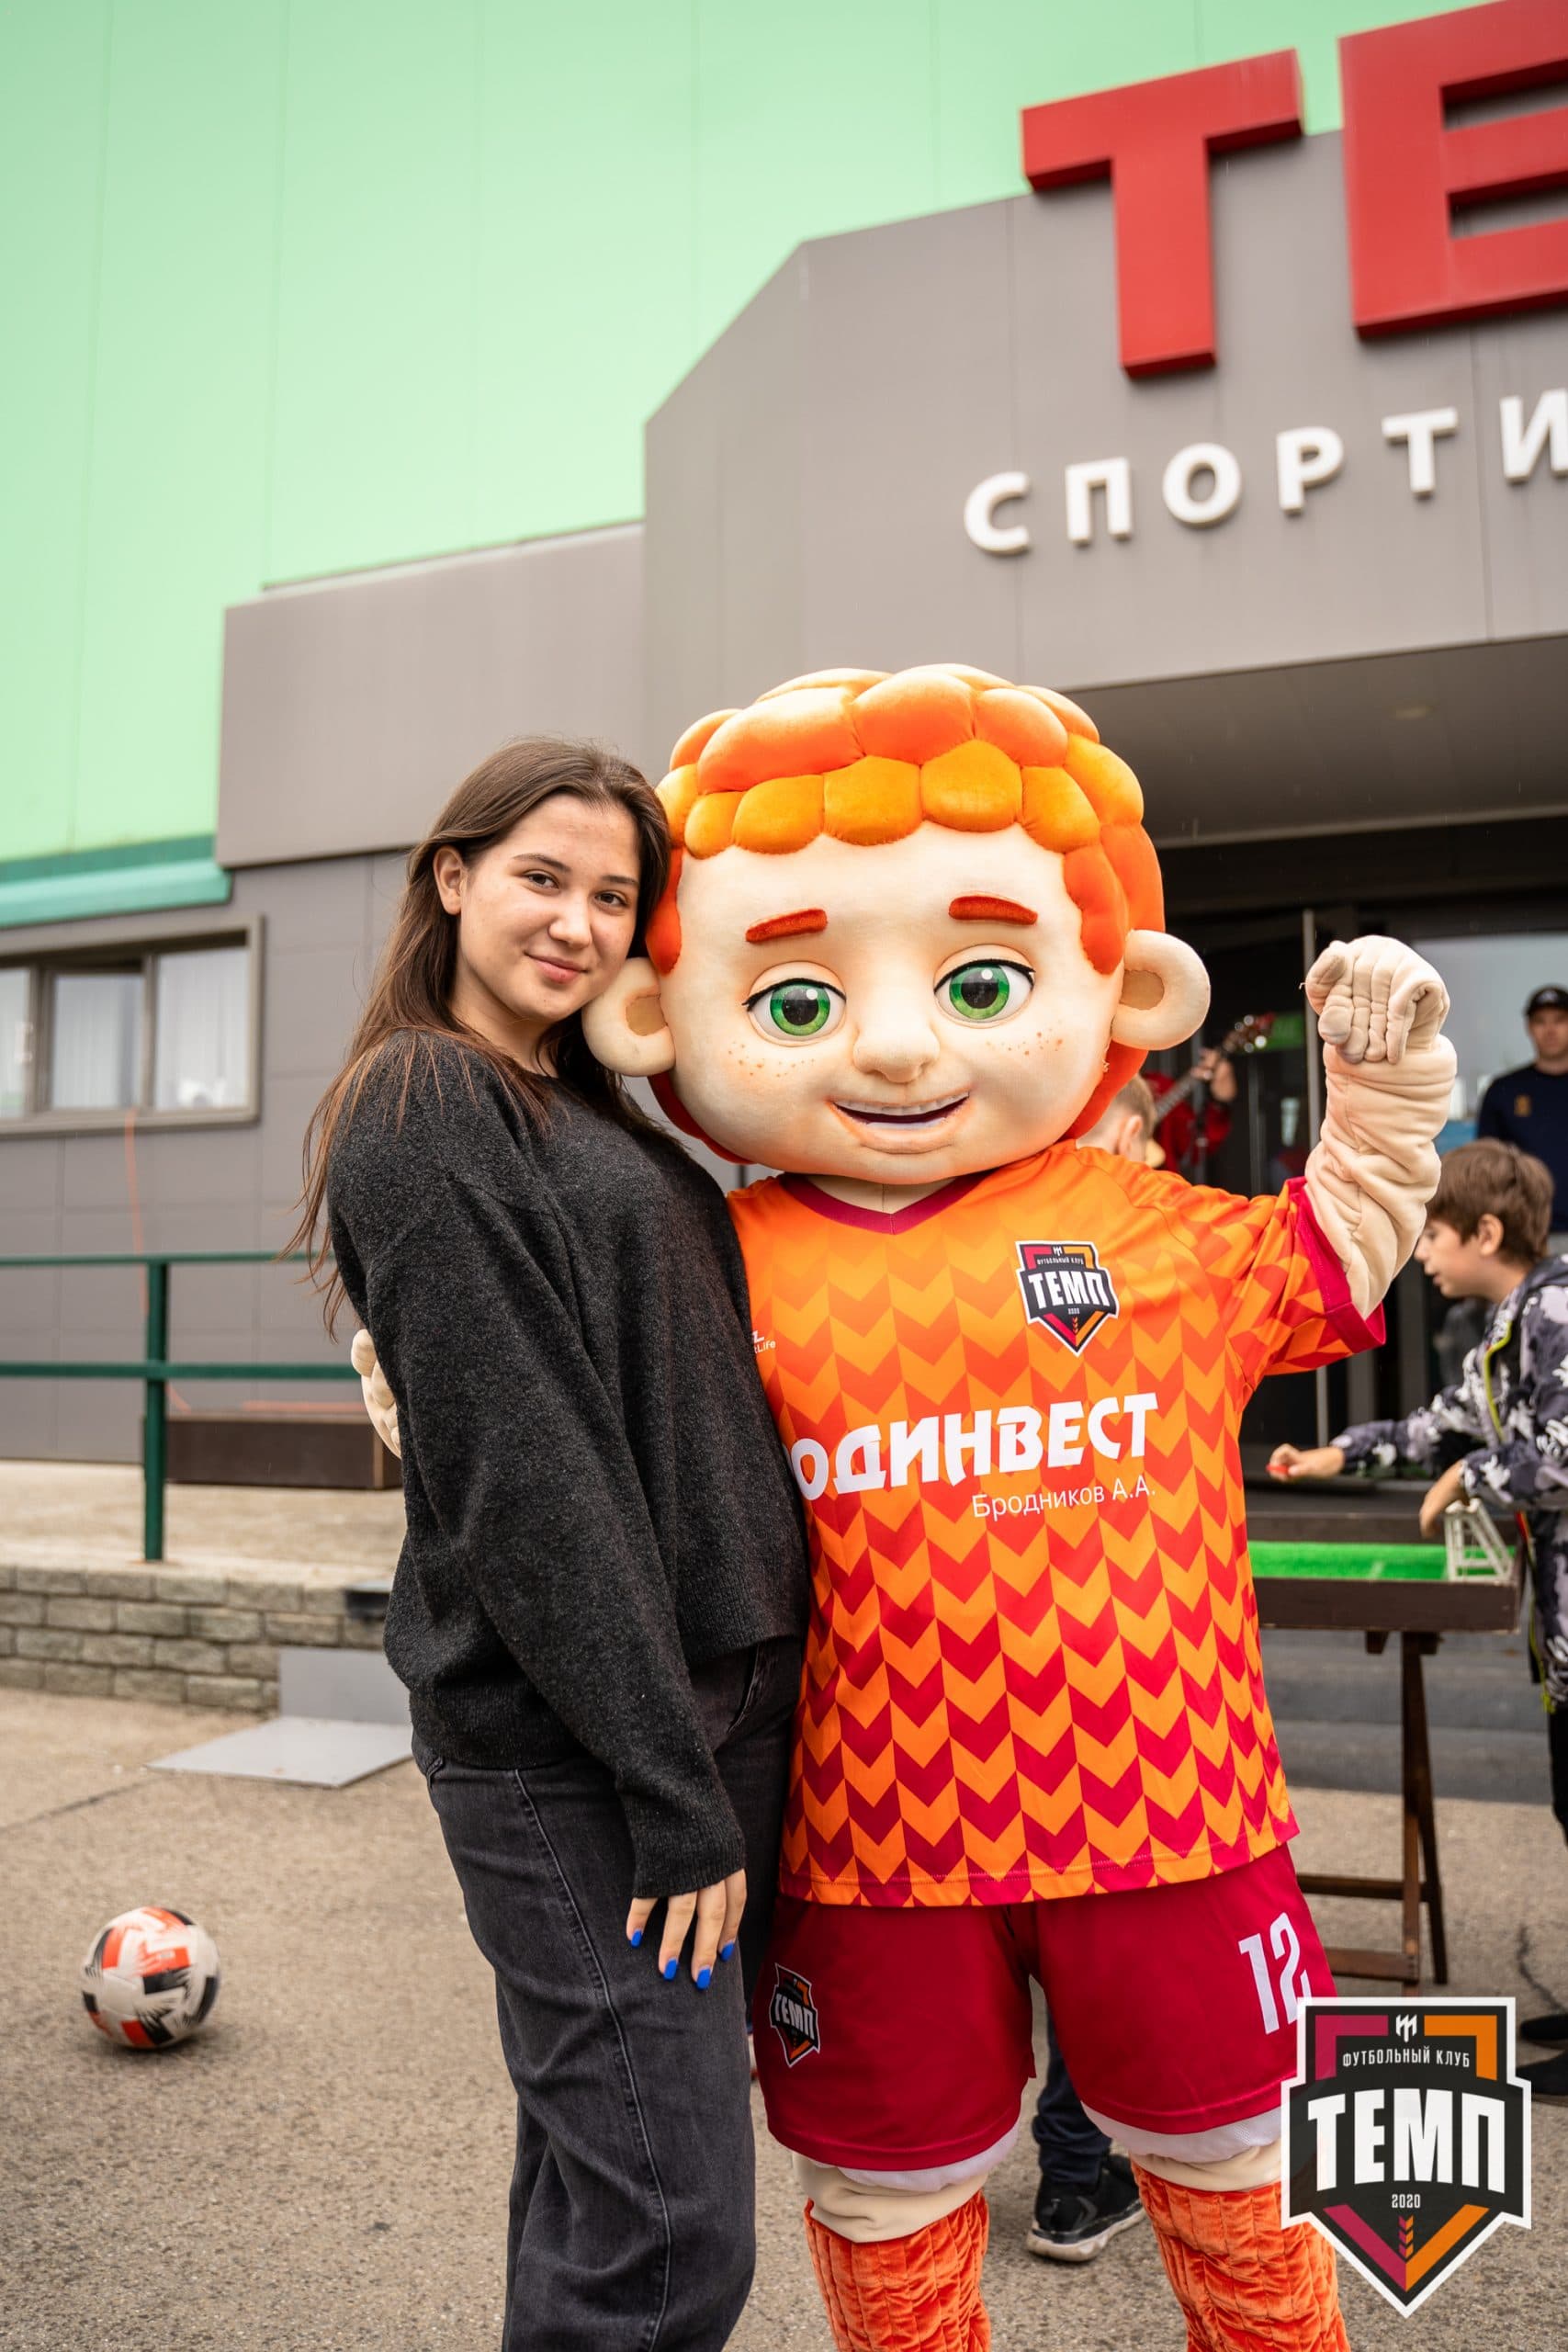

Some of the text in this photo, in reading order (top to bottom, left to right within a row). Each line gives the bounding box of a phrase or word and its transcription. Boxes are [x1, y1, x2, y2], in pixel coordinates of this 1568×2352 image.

[1021, 0, 1568, 379] ТЕ
[964, 388, 1568, 555] СПОРТИ
[1028, 1271, 1110, 1309] ТЕМП
[783, 1392, 1159, 1501] ОДИНВЕСТ
[972, 1475, 1156, 1522] Бродников А.А.
[774, 1993, 815, 2041] ТЕМП
[1238, 1912, 1313, 2035] 12
